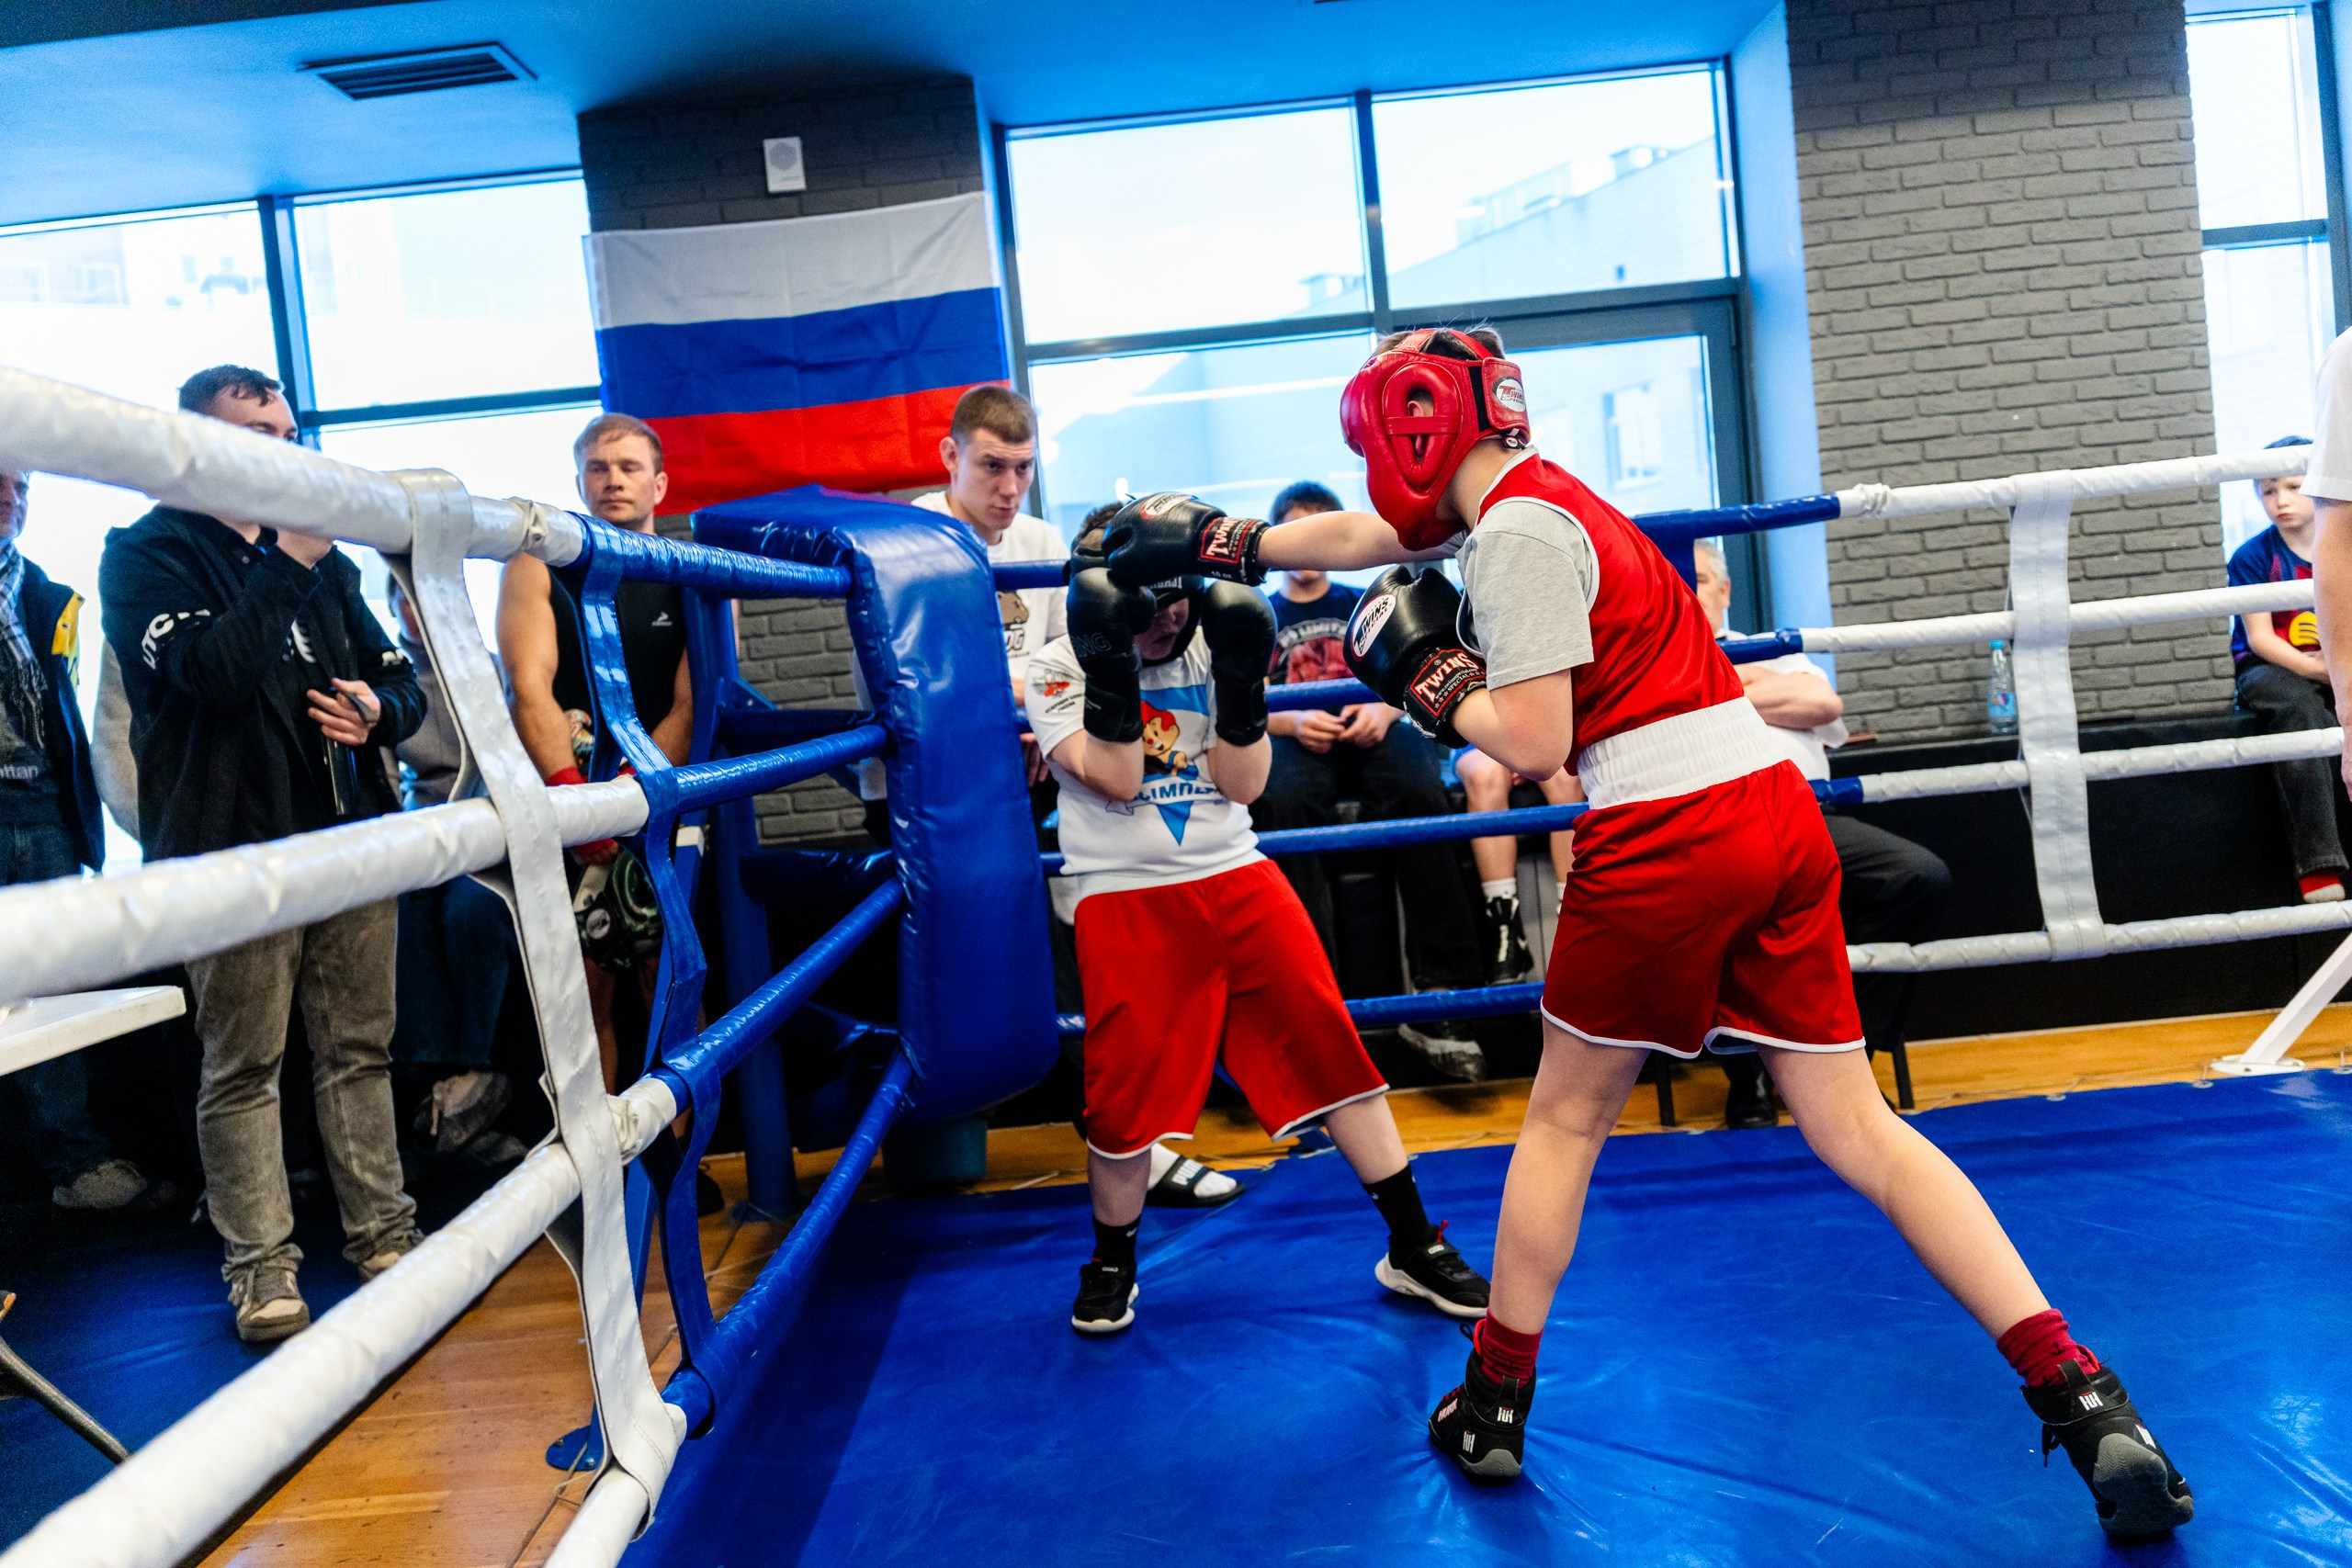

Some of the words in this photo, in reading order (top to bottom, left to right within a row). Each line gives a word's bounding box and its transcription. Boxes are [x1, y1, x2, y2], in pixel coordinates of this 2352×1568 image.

[1353, 597, 1390, 648] TWINS
[1414, 652, 1480, 705] TWINS
[1447, 673, 1471, 693] SPECIAL
